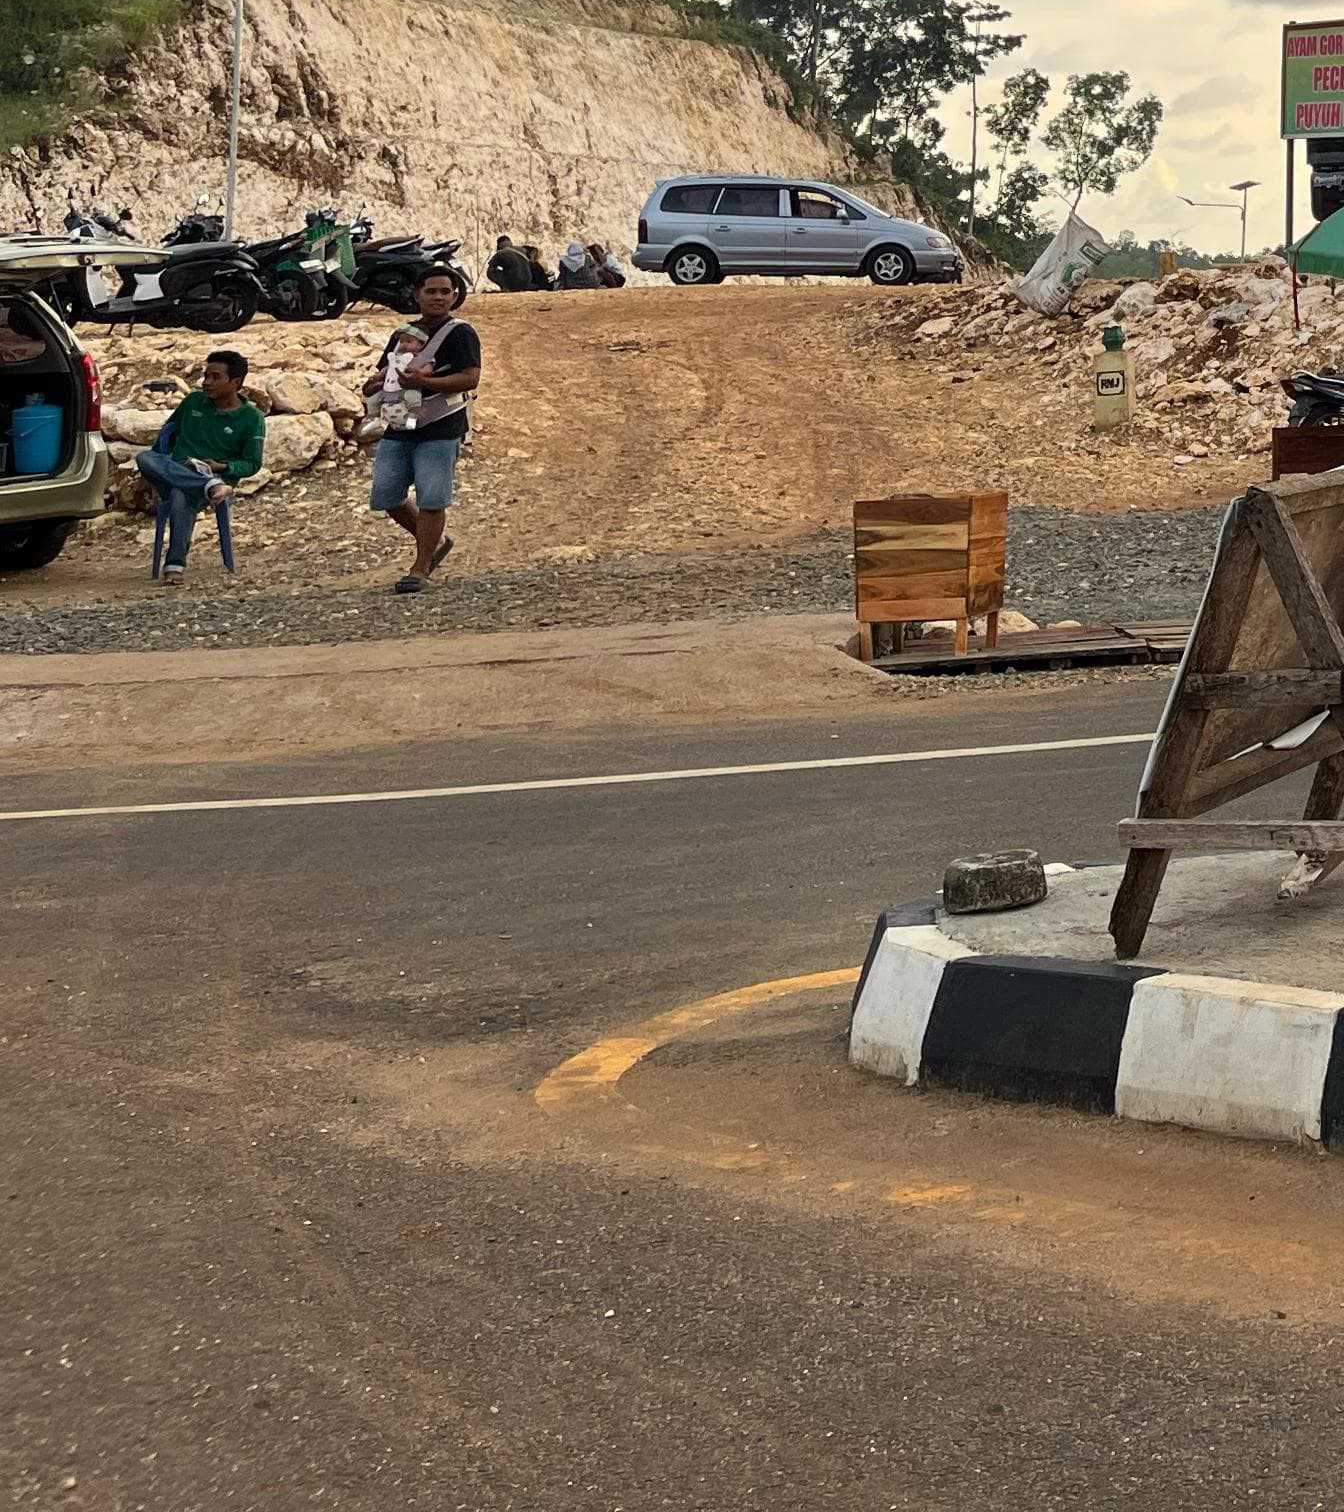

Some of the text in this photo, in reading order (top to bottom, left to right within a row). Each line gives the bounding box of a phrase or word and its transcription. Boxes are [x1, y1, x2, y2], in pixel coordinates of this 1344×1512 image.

[1287, 36, 1317, 57] AYAM
[1295, 102, 1341, 129] PUYUH
[1101, 378, 1119, 389] RMJ
